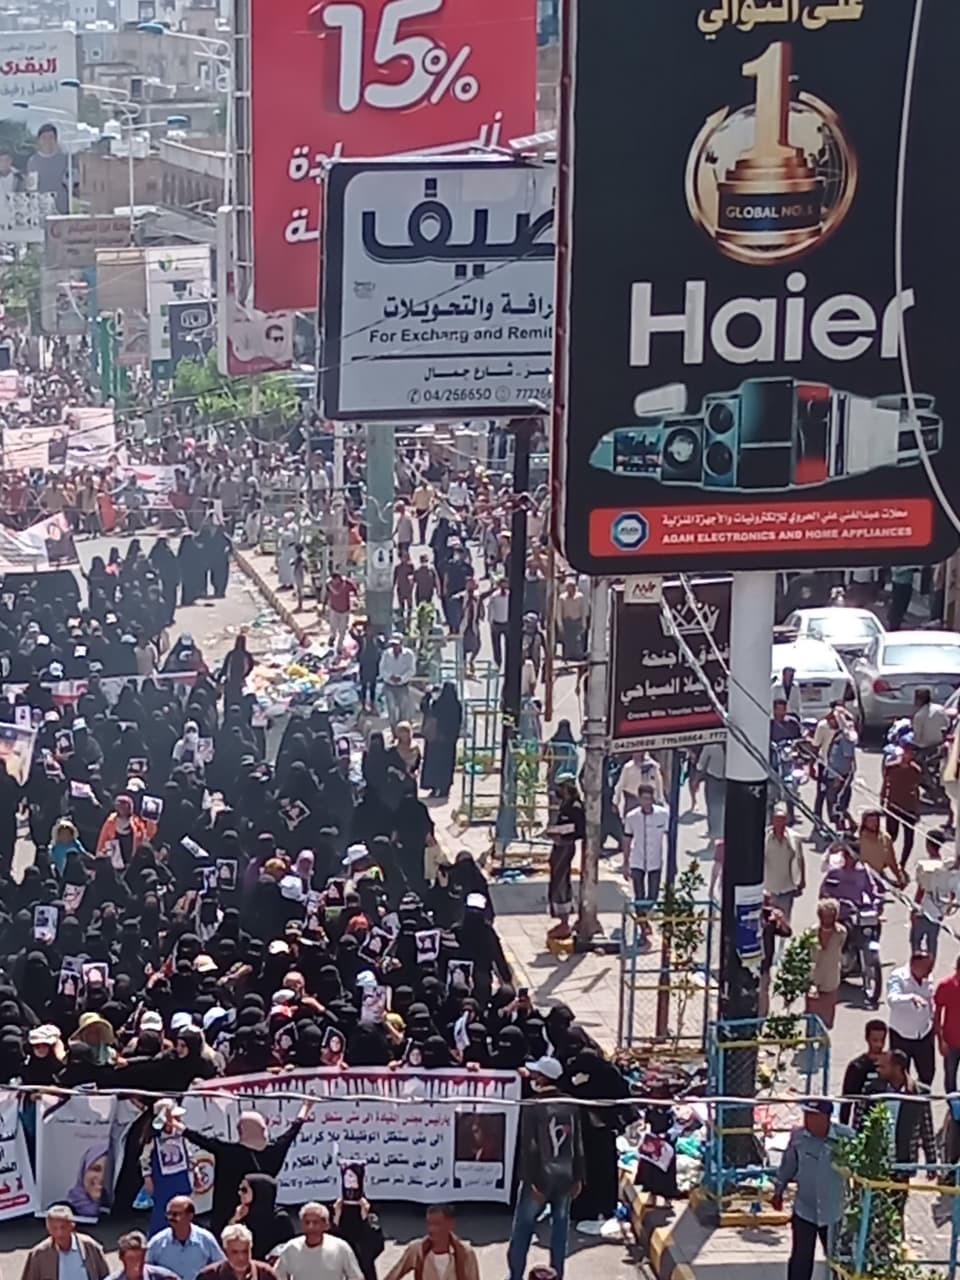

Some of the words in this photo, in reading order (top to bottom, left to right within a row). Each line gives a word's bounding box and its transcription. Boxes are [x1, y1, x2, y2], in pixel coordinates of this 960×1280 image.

[322, 0, 480, 112] 15%
[725, 205, 780, 219] GLOBAL
[383, 294, 494, 323] والتحويلات
[629, 271, 916, 367] Haier
[369, 329, 397, 343] For
[474, 326, 503, 340] and
[424, 367, 470, 382] جمال
[473, 361, 513, 381] شارع
[697, 530, 776, 543] ELECTRONICS
[778, 529, 803, 540] AND
[805, 528, 839, 539] HOME
[841, 526, 913, 538] APPLIANCES
[620, 676, 680, 706] السياحي
